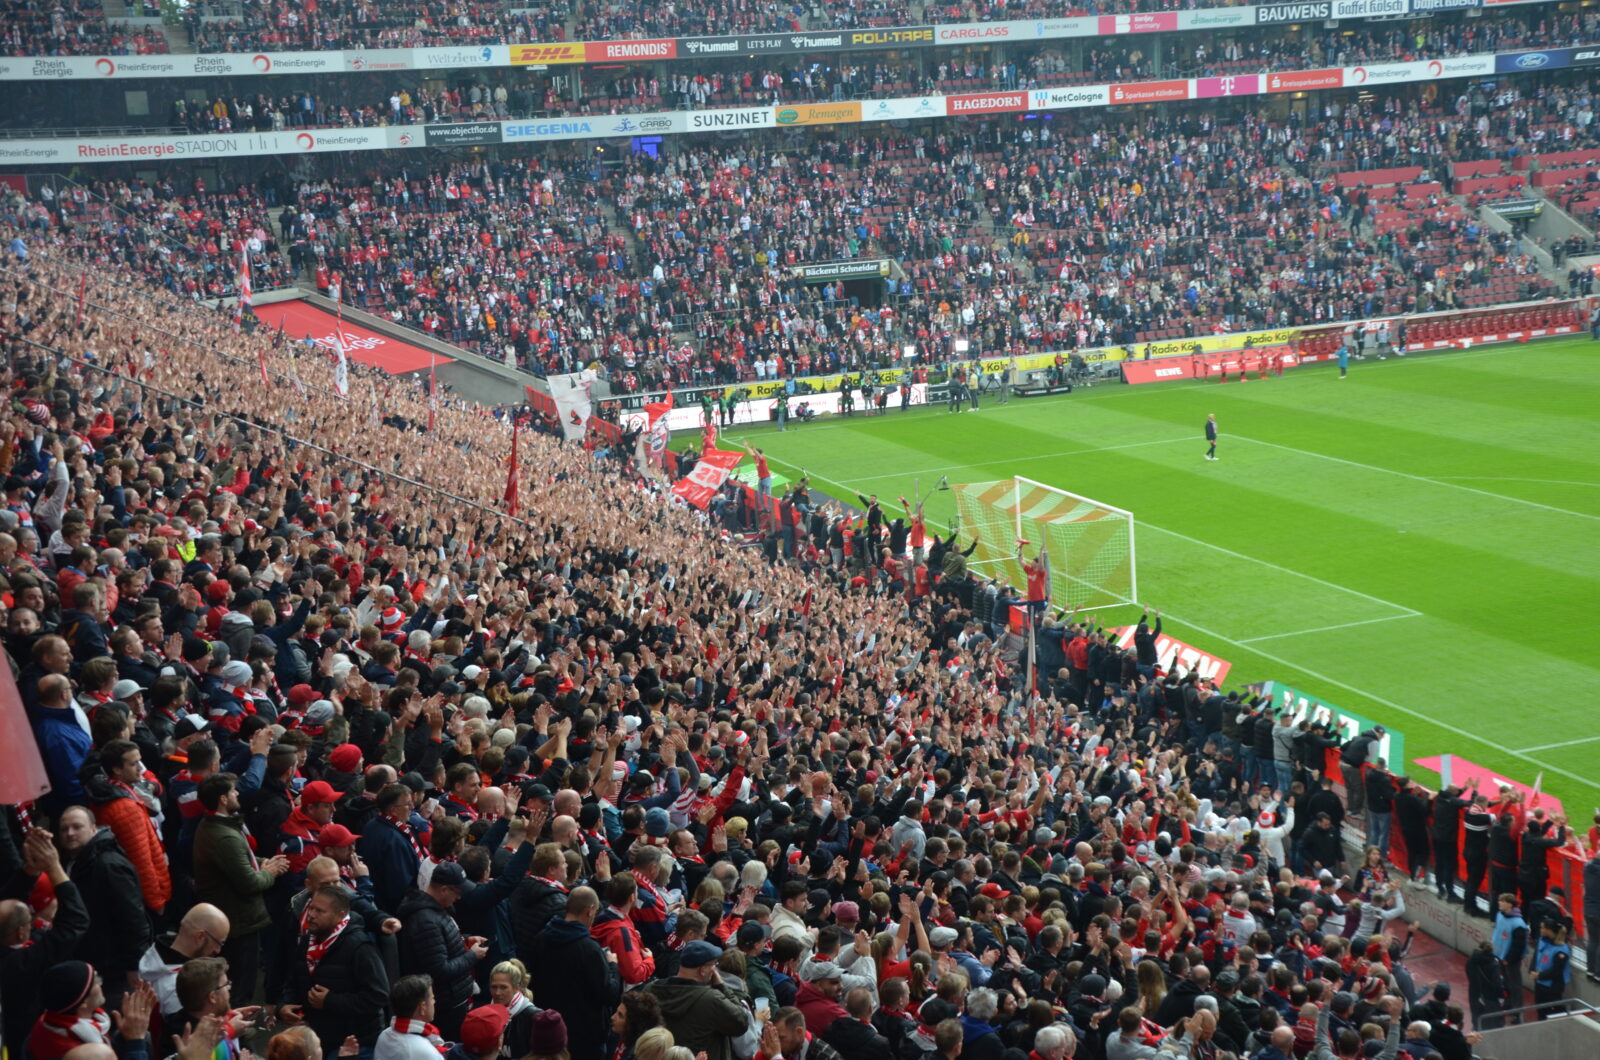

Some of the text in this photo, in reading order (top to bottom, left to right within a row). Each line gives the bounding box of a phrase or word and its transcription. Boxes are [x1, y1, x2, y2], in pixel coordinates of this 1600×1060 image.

[1258, 3, 1329, 22] BAUWENS
[852, 29, 933, 45] POLI-TAPE
[941, 26, 1009, 40] CARGLASS
[699, 40, 739, 52] hummel
[747, 39, 782, 49] LET'S PLAY
[804, 35, 842, 48] hummel
[520, 46, 576, 61] DHL
[35, 58, 66, 69] Rhein
[117, 61, 174, 73] RheinEnergie
[197, 56, 225, 66] Rhein
[273, 57, 326, 69] RheinEnergie
[1444, 61, 1487, 72] RheinEnergie
[32, 66, 73, 77] Energie
[194, 63, 232, 74] Energie
[1368, 67, 1411, 78] RheinEnergie
[953, 96, 1022, 111] HAGEDORN
[1051, 91, 1103, 104] NetCologne
[694, 111, 769, 127] SUNZINET
[808, 107, 853, 120] Remagen
[506, 122, 592, 137] SIEGENIA
[639, 119, 672, 128] CARBO
[317, 135, 369, 147] RheinEnergie
[806, 263, 878, 276] Bäckerei Schneider
[1152, 343, 1179, 355] Radio
[1154, 367, 1183, 377] REWE
